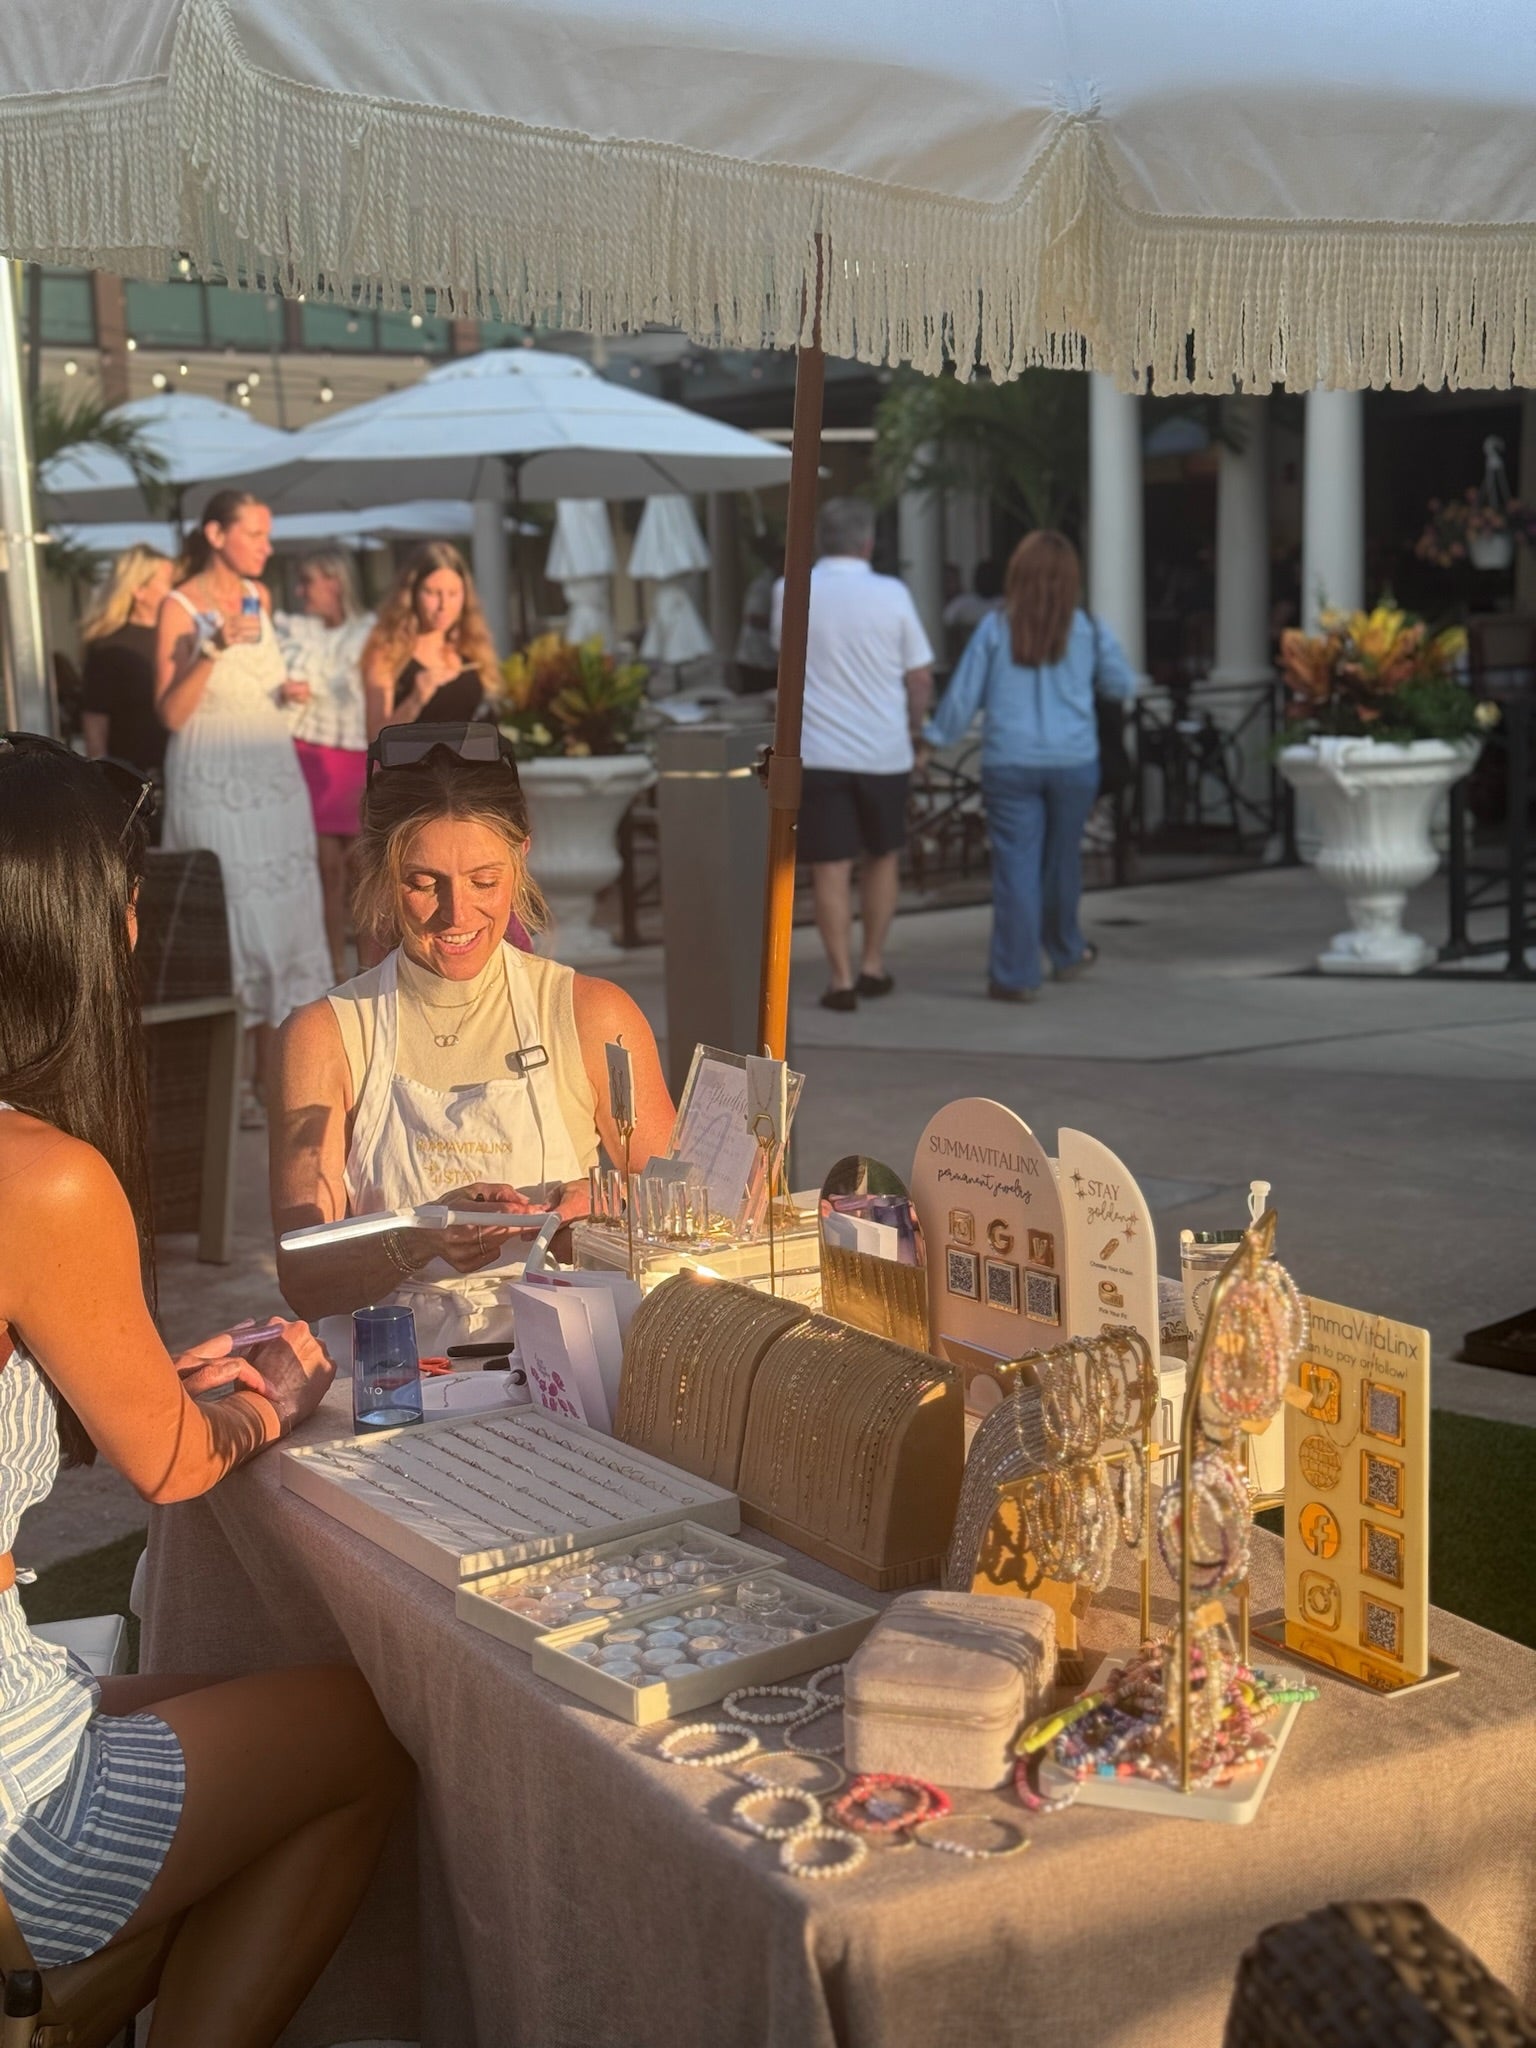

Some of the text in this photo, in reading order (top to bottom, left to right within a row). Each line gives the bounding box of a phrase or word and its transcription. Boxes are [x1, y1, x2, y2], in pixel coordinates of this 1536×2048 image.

[929, 1135, 1040, 1177] SUMMAVITALINX
[937, 1168, 994, 1191] permanent
[1088, 1179, 1120, 1201] STAY
[1086, 1200, 1129, 1226] golden
[1309, 1314, 1418, 1360] mmaVitaLinx
[1323, 1343, 1334, 1359] to
[1336, 1351, 1357, 1368] pay
